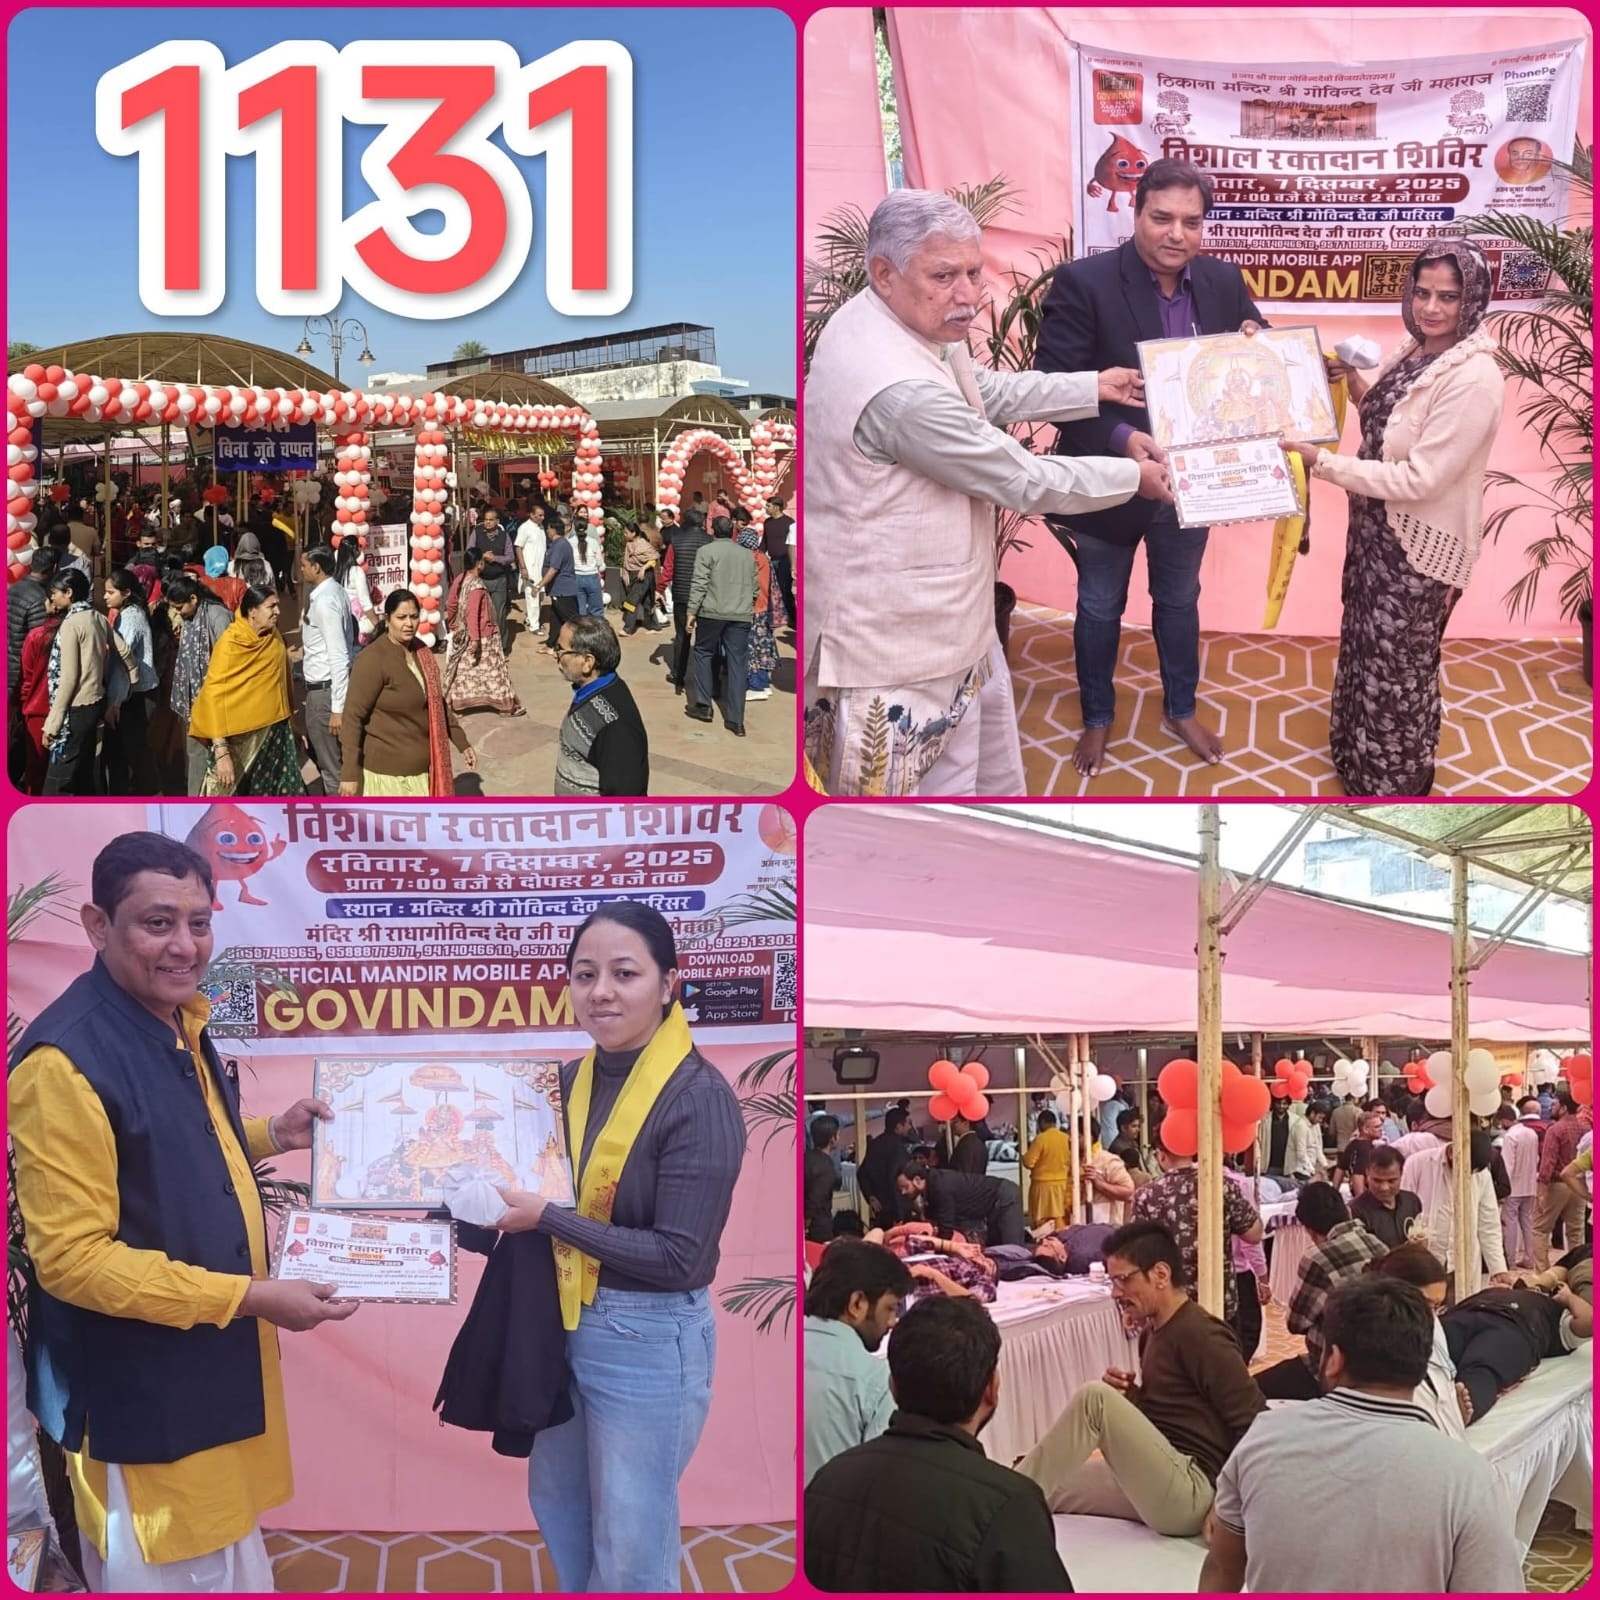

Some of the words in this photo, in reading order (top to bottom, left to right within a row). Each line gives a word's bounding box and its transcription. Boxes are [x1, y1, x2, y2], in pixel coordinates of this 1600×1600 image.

[1504, 67, 1557, 80] PhonePe
[1157, 72, 1215, 91] ठिकाना
[1222, 81, 1271, 95] मन्दिर
[1279, 84, 1297, 97] श्री
[1303, 85, 1362, 98] गोविन्द
[1369, 83, 1396, 96] देव
[1401, 78, 1424, 93] जी
[1429, 73, 1494, 91] महाराज
[1160, 137, 1262, 170] विशाल
[1267, 149, 1388, 171] रक्तदान
[1394, 137, 1488, 170] शिविर
[1274, 179, 1289, 190] 7
[1395, 178, 1461, 190] 2025
[1231, 193, 1270, 202] 7:00
[1274, 191, 1300, 202] बजे
[1303, 191, 1318, 202] से
[1321, 190, 1368, 203] दोपहर
[1371, 193, 1382, 202] 2
[1385, 190, 1413, 203] बजे
[1415, 192, 1443, 202] तक
[1244, 208, 1283, 220] मन्दिर
[1286, 208, 1304, 221] श्री
[1306, 208, 1354, 221] गोविन्द
[1357, 208, 1377, 221] देव
[1380, 208, 1399, 221] जी
[1401, 208, 1445, 221] परिसर
[1208, 224, 1224, 237] श्री
[1226, 224, 1300, 238] राधागोविन्द
[1302, 225, 1323, 238] देव
[1325, 225, 1344, 238] जी
[1346, 226, 1385, 239] चाकर
[1272, 253, 1329, 267] MOBILE
[1331, 254, 1362, 267] APP
[1242, 268, 1359, 299] NDAM
[217, 437, 249, 459] बिना
[253, 437, 276, 464] जूते
[279, 441, 314, 458] चप्पल
[365, 553, 402, 568] विशाल
[283, 804, 431, 843] विशाल
[438, 807, 612, 843] रक्तदान
[620, 804, 744, 838] शिविर
[452, 856, 473, 872] 7
[625, 849, 713, 868] 2025
[344, 877, 387, 893] प्रात
[390, 877, 447, 892] 7:00
[453, 874, 490, 892] बजे
[495, 874, 518, 890] से
[518, 872, 585, 890] दोपहर
[590, 875, 605, 888] 2
[611, 870, 647, 886] बजे
[651, 870, 688, 885] तक
[343, 902, 394, 917] स्थान
[409, 900, 466, 917] मन्दिर
[471, 900, 497, 917] श्री
[498, 896, 568, 917] गोविन्द
[570, 896, 599, 913] देव
[632, 895, 692, 911] रिसर
[305, 924, 352, 943] मंदिर
[357, 922, 382, 942] श्री
[386, 922, 492, 943] राधागोविन्द
[495, 922, 524, 941] देव
[527, 922, 554, 941] जी
[715, 934, 797, 949] 982913303
[688, 953, 755, 966] DOWNLOAD
[361, 964, 448, 984] MANDIR
[453, 963, 532, 982] MOBILE
[714, 967, 737, 978] APP
[738, 965, 771, 977] FROM
[705, 987, 738, 998] Google
[740, 986, 759, 997] Play
[264, 985, 575, 1031] GOVINDAM
[706, 1011, 728, 1021] App
[730, 1010, 759, 1019] Store
